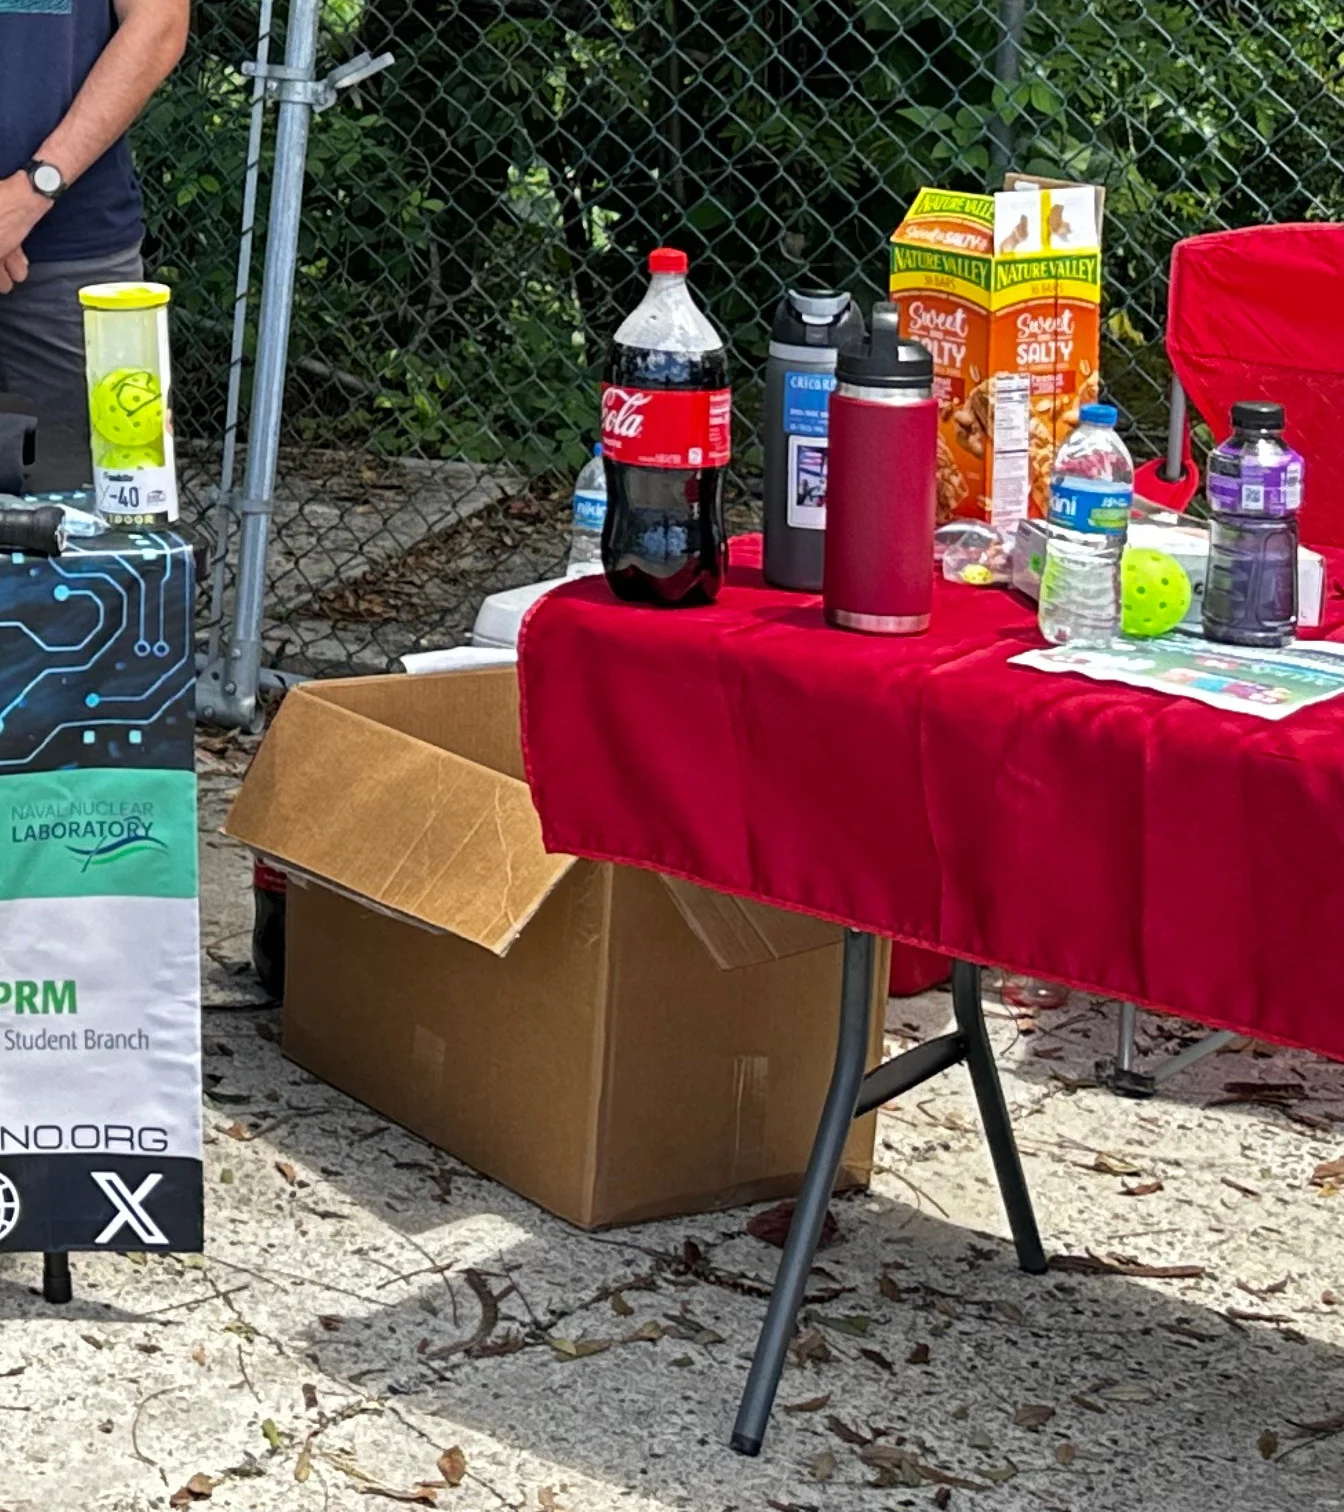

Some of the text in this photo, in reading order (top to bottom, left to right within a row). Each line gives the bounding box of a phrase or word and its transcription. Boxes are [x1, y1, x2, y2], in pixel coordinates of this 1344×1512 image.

[919, 194, 994, 220] NATURE VALLE
[893, 247, 988, 287] NATURE VALLEY
[997, 259, 1096, 289] NATURE VALLEY
[909, 302, 969, 337] Sweet
[1016, 309, 1075, 338] Sweet
[920, 337, 966, 368] ALTY
[1016, 340, 1073, 365] SALTY
[12, 800, 154, 820] NAVAL NUCLEAR
[12, 820, 154, 843] LABORATORY
[3, 1029, 80, 1052] Student
[83, 1028, 151, 1052] Branch
